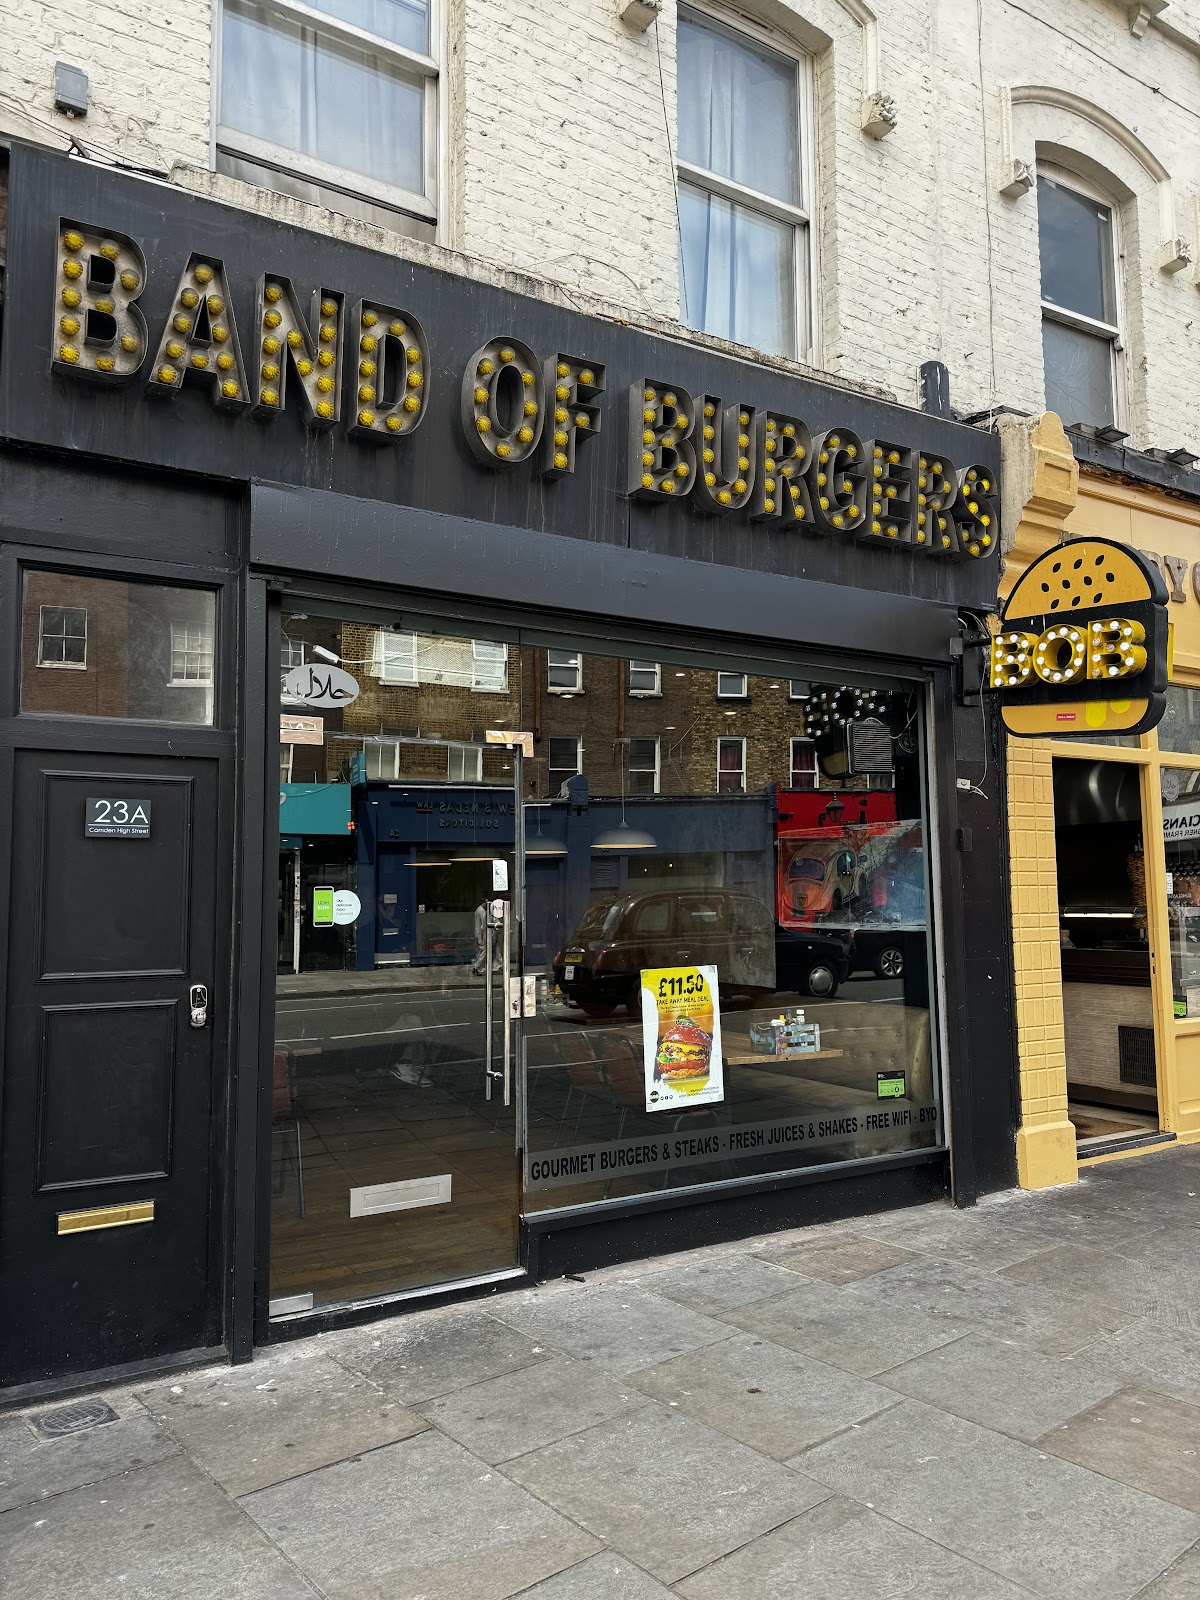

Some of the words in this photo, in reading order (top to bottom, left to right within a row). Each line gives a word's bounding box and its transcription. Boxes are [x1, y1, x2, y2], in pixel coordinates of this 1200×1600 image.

[50, 216, 431, 440] BAND
[460, 335, 606, 478] OF
[627, 377, 999, 560] BURGERS
[990, 618, 1149, 689] BOB
[94, 799, 149, 824] 23A
[116, 827, 131, 835] High
[658, 973, 704, 998] £11.50
[531, 1153, 596, 1181] GOURMET
[600, 1145, 658, 1170] BURGERS
[662, 1142, 671, 1160] &
[674, 1135, 720, 1159] STEAKS
[729, 1129, 764, 1150] FRESH
[767, 1124, 805, 1145] JUICES
[808, 1122, 815, 1139] &
[818, 1117, 858, 1138] SHAKES
[866, 1112, 890, 1131] FREE
[891, 1109, 912, 1127] WIFI
[919, 1106, 938, 1123] BYO
